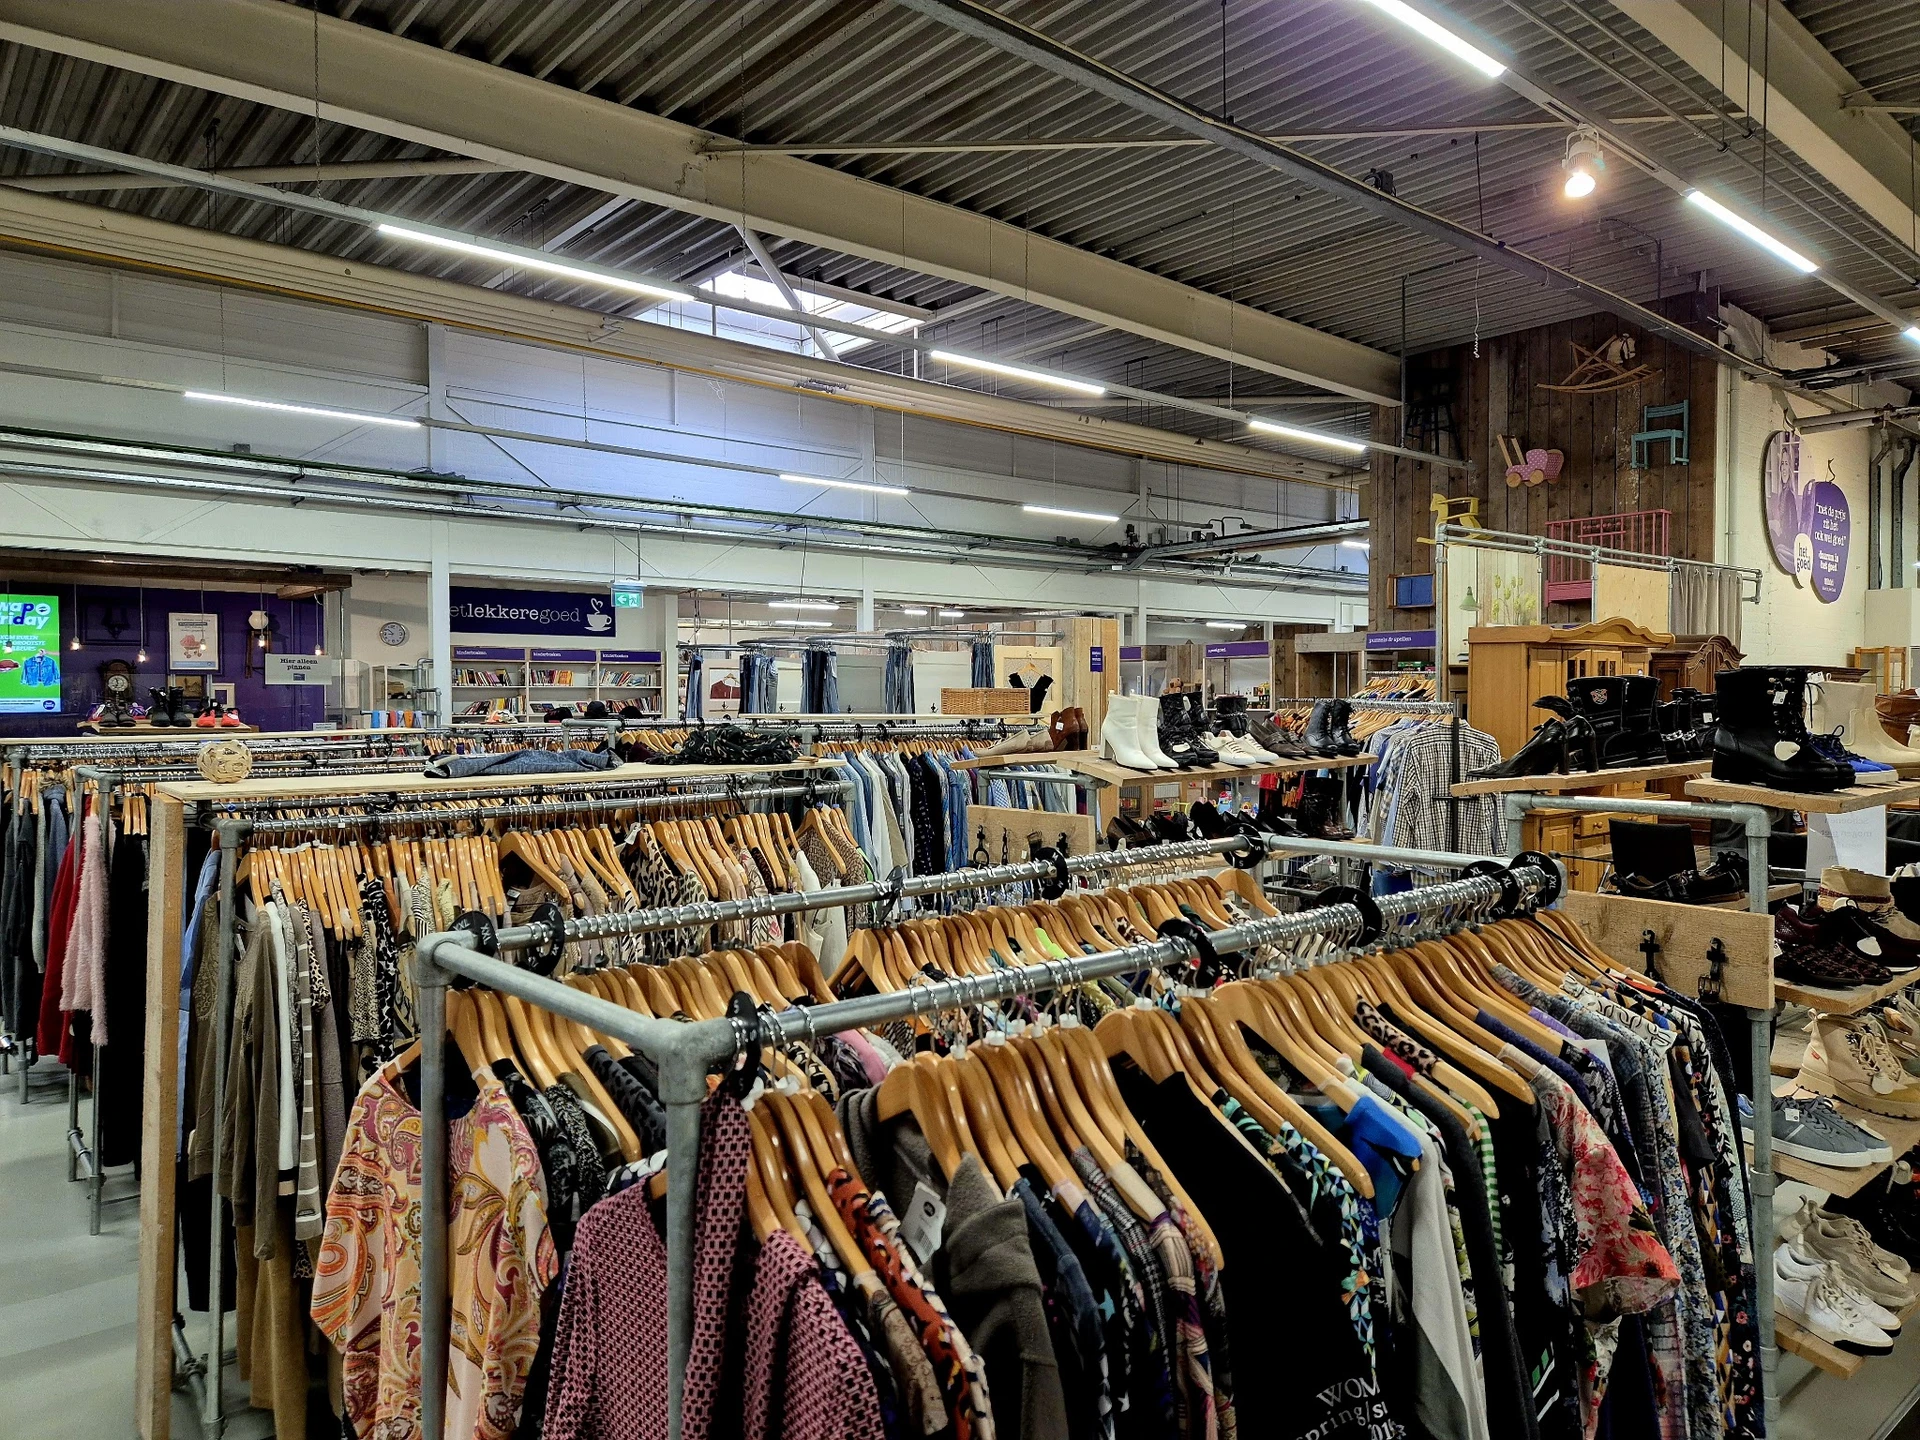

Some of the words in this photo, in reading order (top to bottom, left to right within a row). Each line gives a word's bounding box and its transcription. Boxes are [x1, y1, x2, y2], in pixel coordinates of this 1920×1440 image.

[1798, 543, 1808, 558] het
[1797, 556, 1811, 573] goed
[0, 602, 35, 617] wap
[449, 603, 581, 625] etlekkeregoed
[0, 610, 50, 630] riday
[1238, 826, 1245, 834] S
[1526, 854, 1542, 865] XXL
[1469, 866, 1484, 876] XL
[1501, 876, 1513, 889] XL
[733, 999, 740, 1014] S
[1315, 1376, 1381, 1407] WOM
[1295, 1400, 1389, 1440] pring/s
